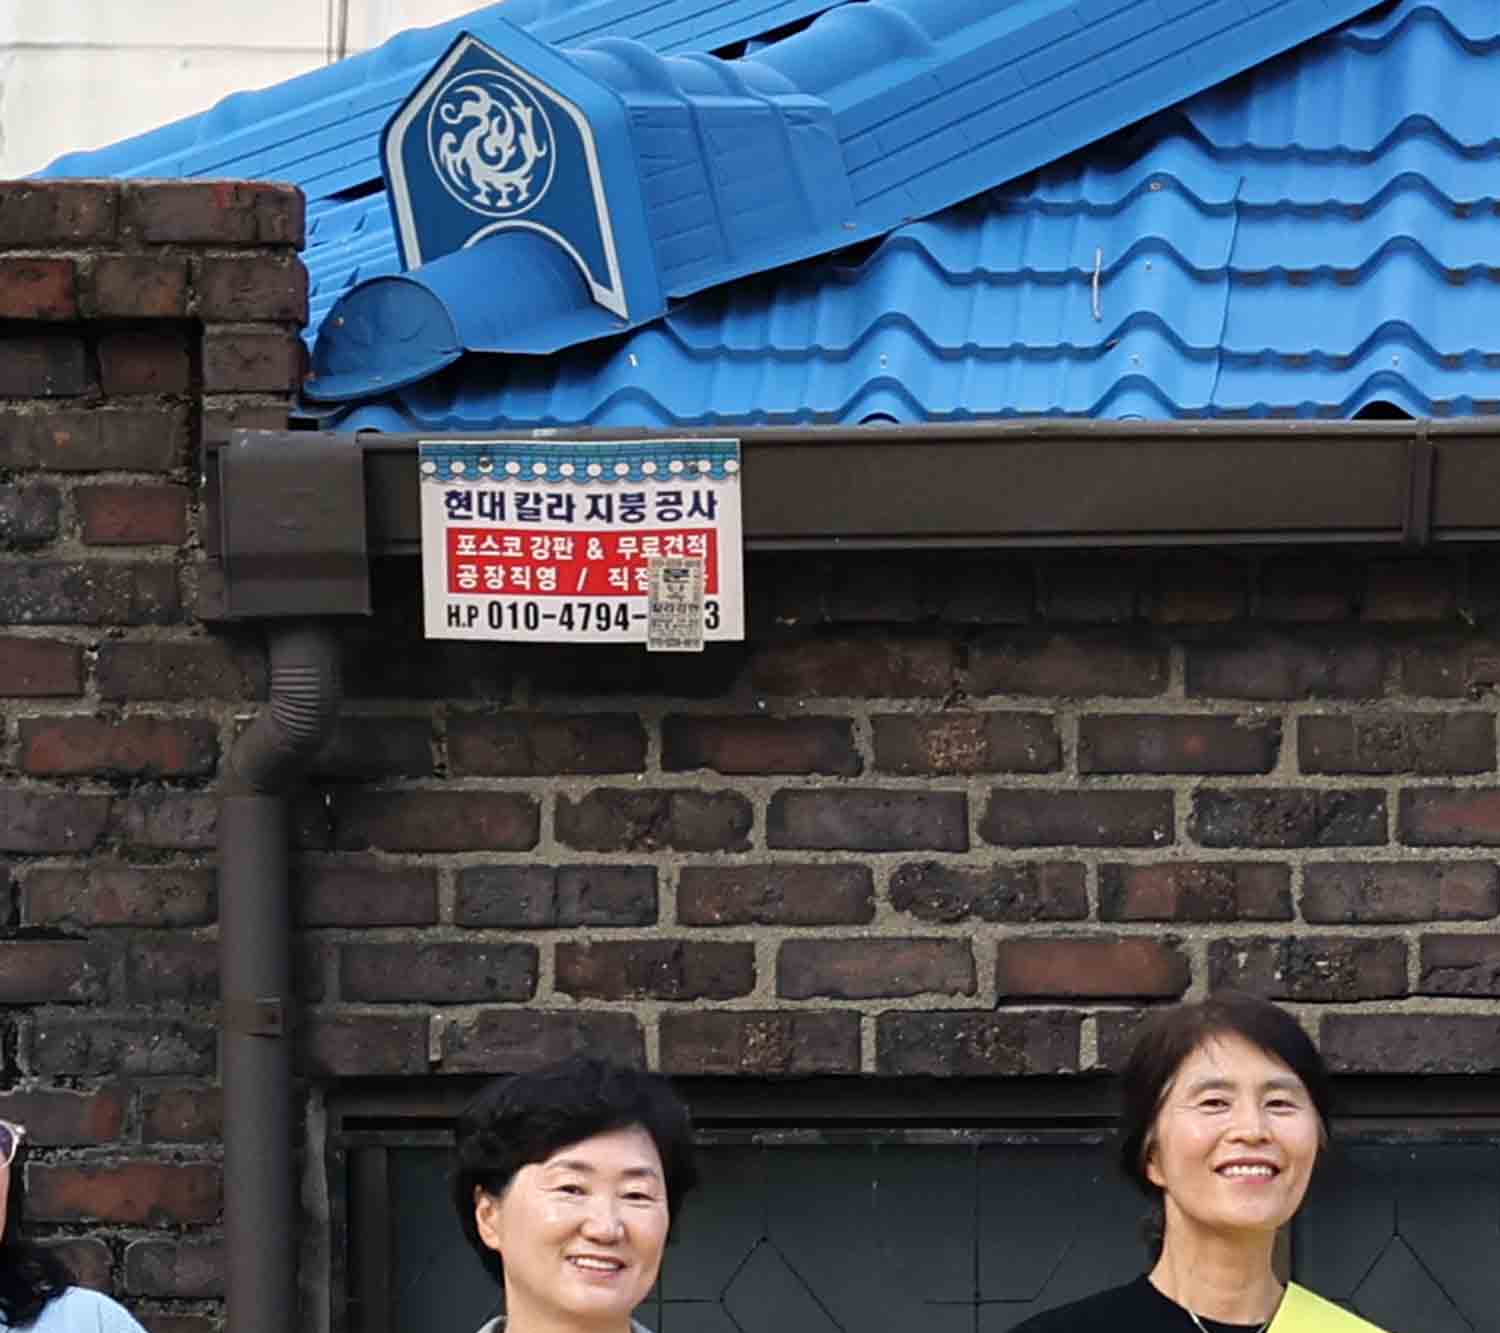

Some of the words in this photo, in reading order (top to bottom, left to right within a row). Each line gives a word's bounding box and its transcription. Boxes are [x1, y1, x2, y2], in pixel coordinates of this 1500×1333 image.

[445, 490, 505, 521] 현대
[514, 490, 576, 523] 칼라
[586, 492, 645, 523] 지붕
[656, 490, 717, 520] 공사
[456, 534, 524, 557] 포스코
[531, 535, 573, 561] 강판
[586, 536, 604, 560] &
[616, 533, 707, 560] 무료견적
[456, 566, 557, 592] 공장직영
[447, 604, 479, 629] H.P
[487, 601, 719, 632] 010-4794-3
